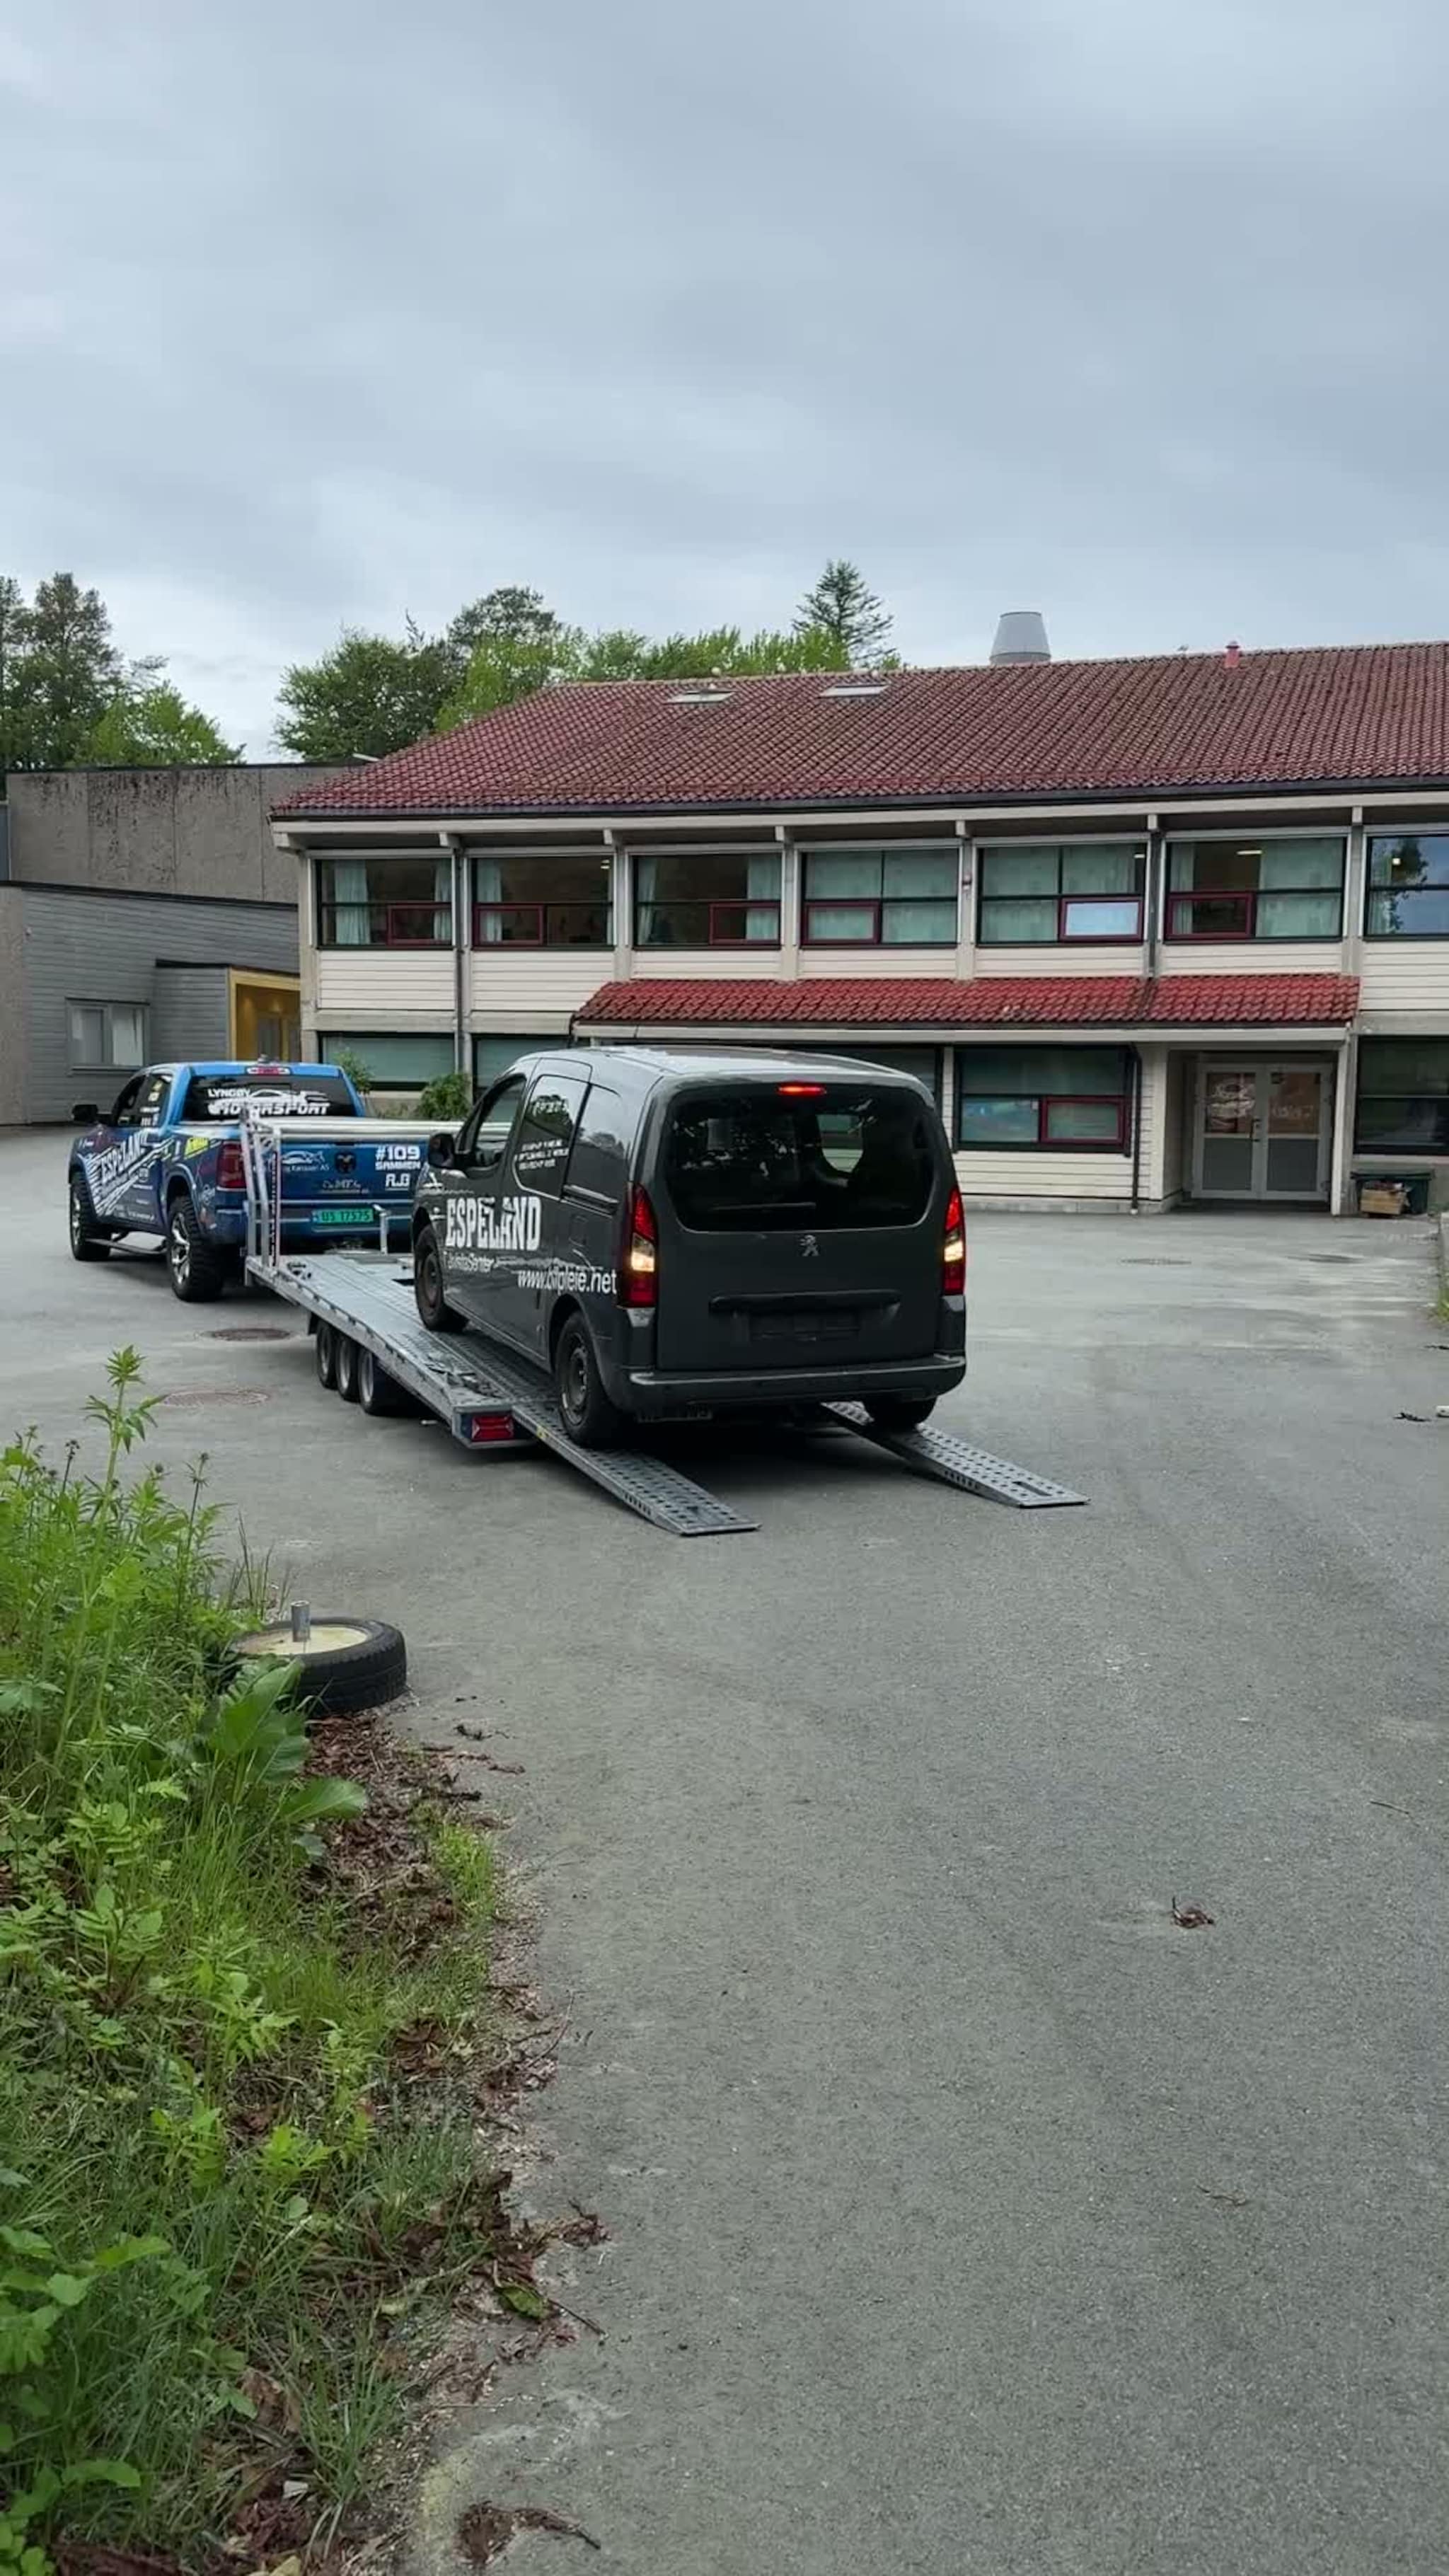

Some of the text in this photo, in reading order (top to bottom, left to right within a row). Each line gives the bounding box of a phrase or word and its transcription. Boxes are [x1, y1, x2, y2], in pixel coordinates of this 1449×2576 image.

[208, 1102, 330, 1116] MOORSPORT
[375, 1145, 420, 1160] #109
[445, 1196, 541, 1250] ESPELAND
